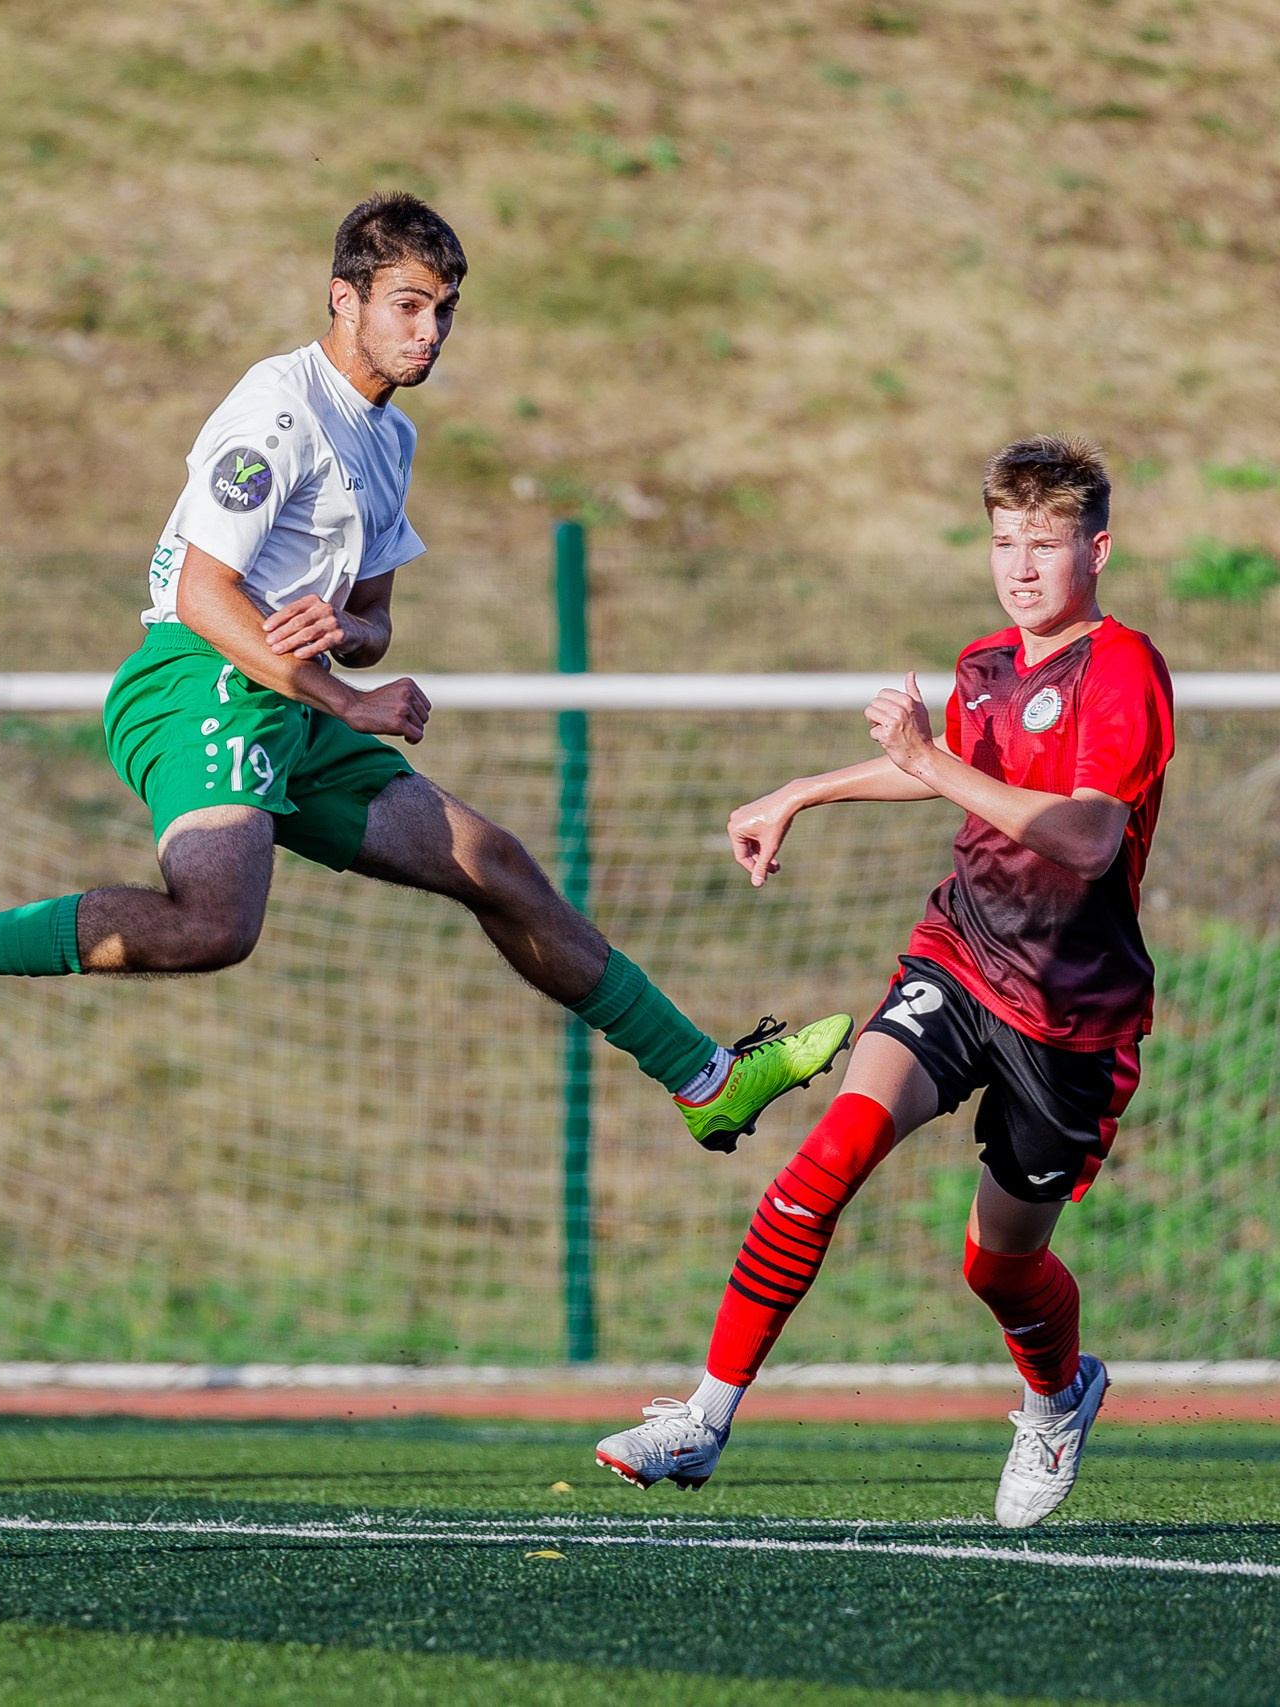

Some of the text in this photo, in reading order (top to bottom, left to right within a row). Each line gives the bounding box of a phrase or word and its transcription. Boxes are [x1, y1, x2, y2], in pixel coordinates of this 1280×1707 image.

[215, 477, 249, 506] ЮФЛ
[226, 735, 274, 796] 19
[882, 981, 943, 1038] 2
[726, 1071, 743, 1099] COPA
